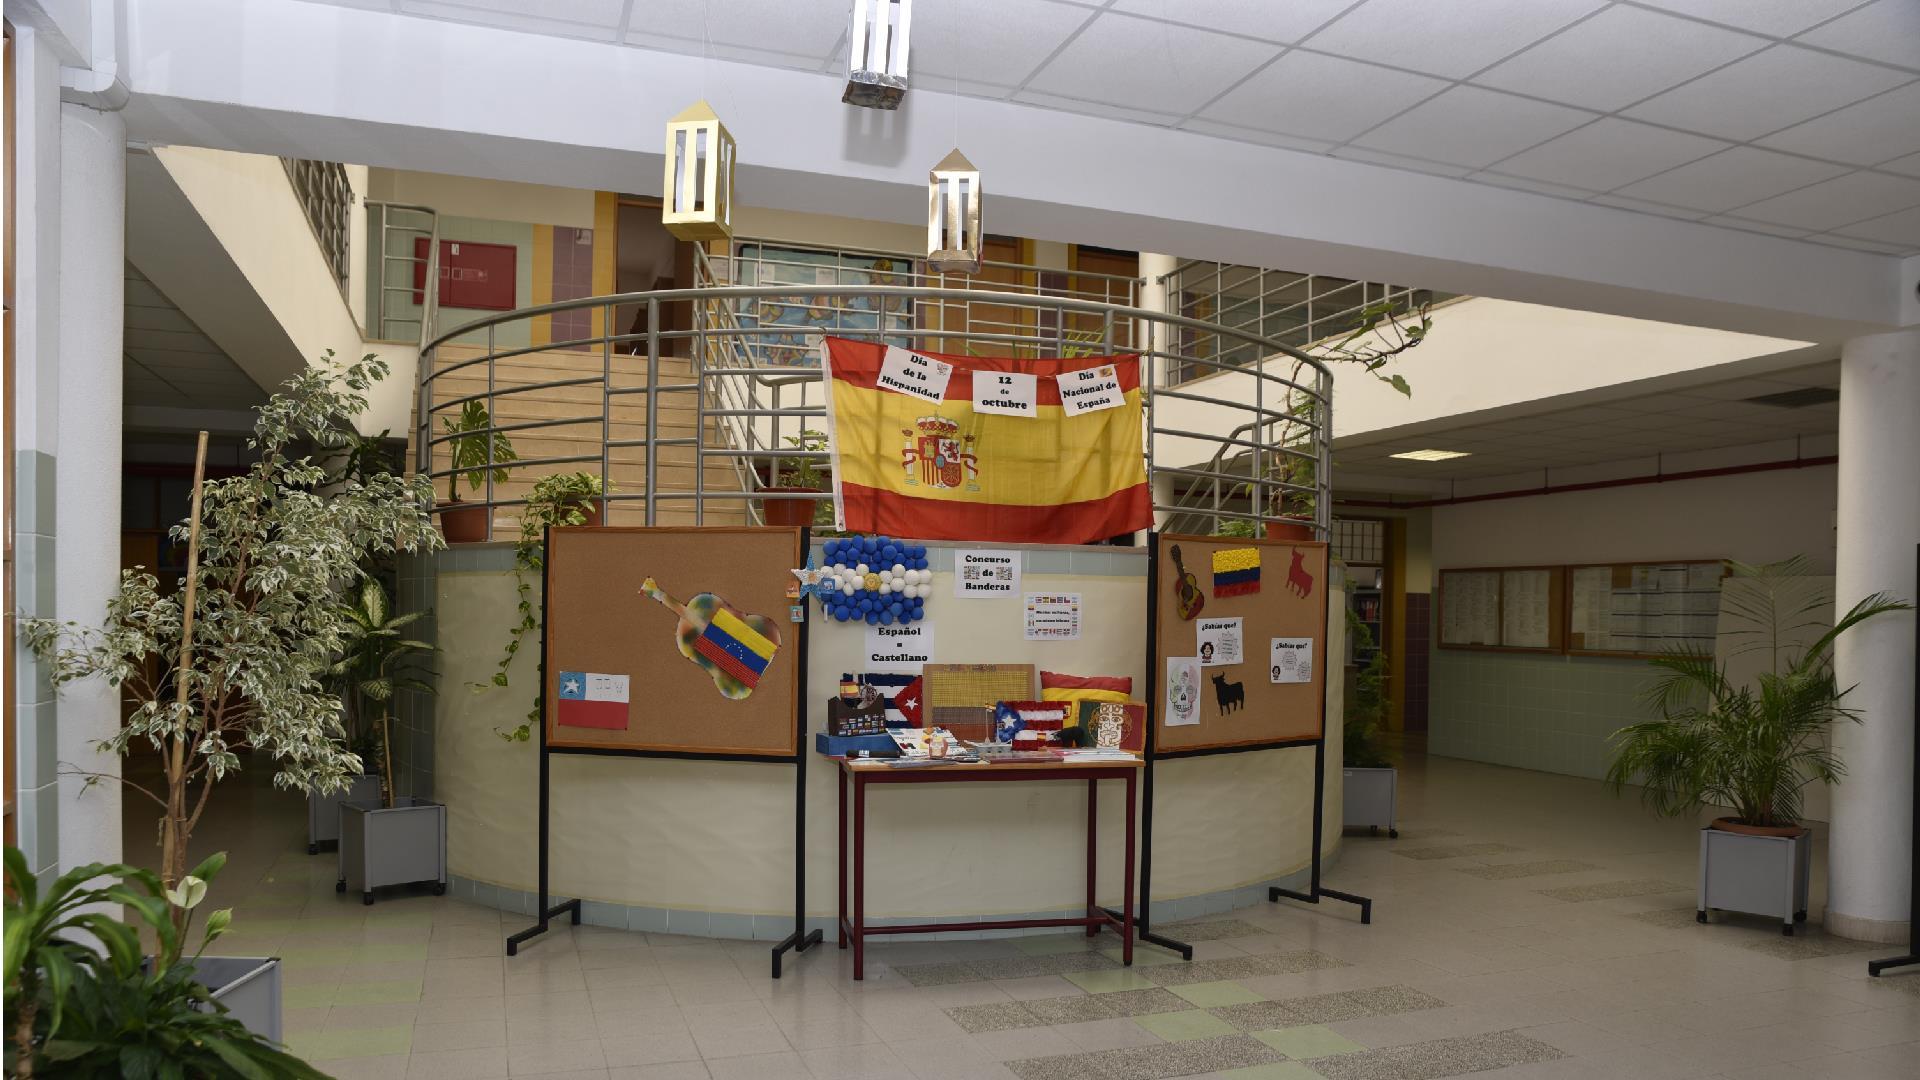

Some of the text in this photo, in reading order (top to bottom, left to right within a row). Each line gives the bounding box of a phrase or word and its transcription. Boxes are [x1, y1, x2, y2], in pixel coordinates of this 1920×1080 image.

[909, 354, 928, 367] Día
[902, 367, 927, 381] de la
[1078, 371, 1095, 381] Día
[998, 376, 1012, 385] 12
[881, 375, 940, 401] Hispanidad
[1062, 382, 1117, 399] Nacional de
[981, 399, 1028, 410] octubre
[1076, 396, 1111, 410] España
[965, 554, 1011, 564] Concurso
[982, 569, 994, 577] de
[965, 582, 1011, 591] Banderas
[877, 626, 921, 637] Español
[871, 653, 928, 662] Castellano
